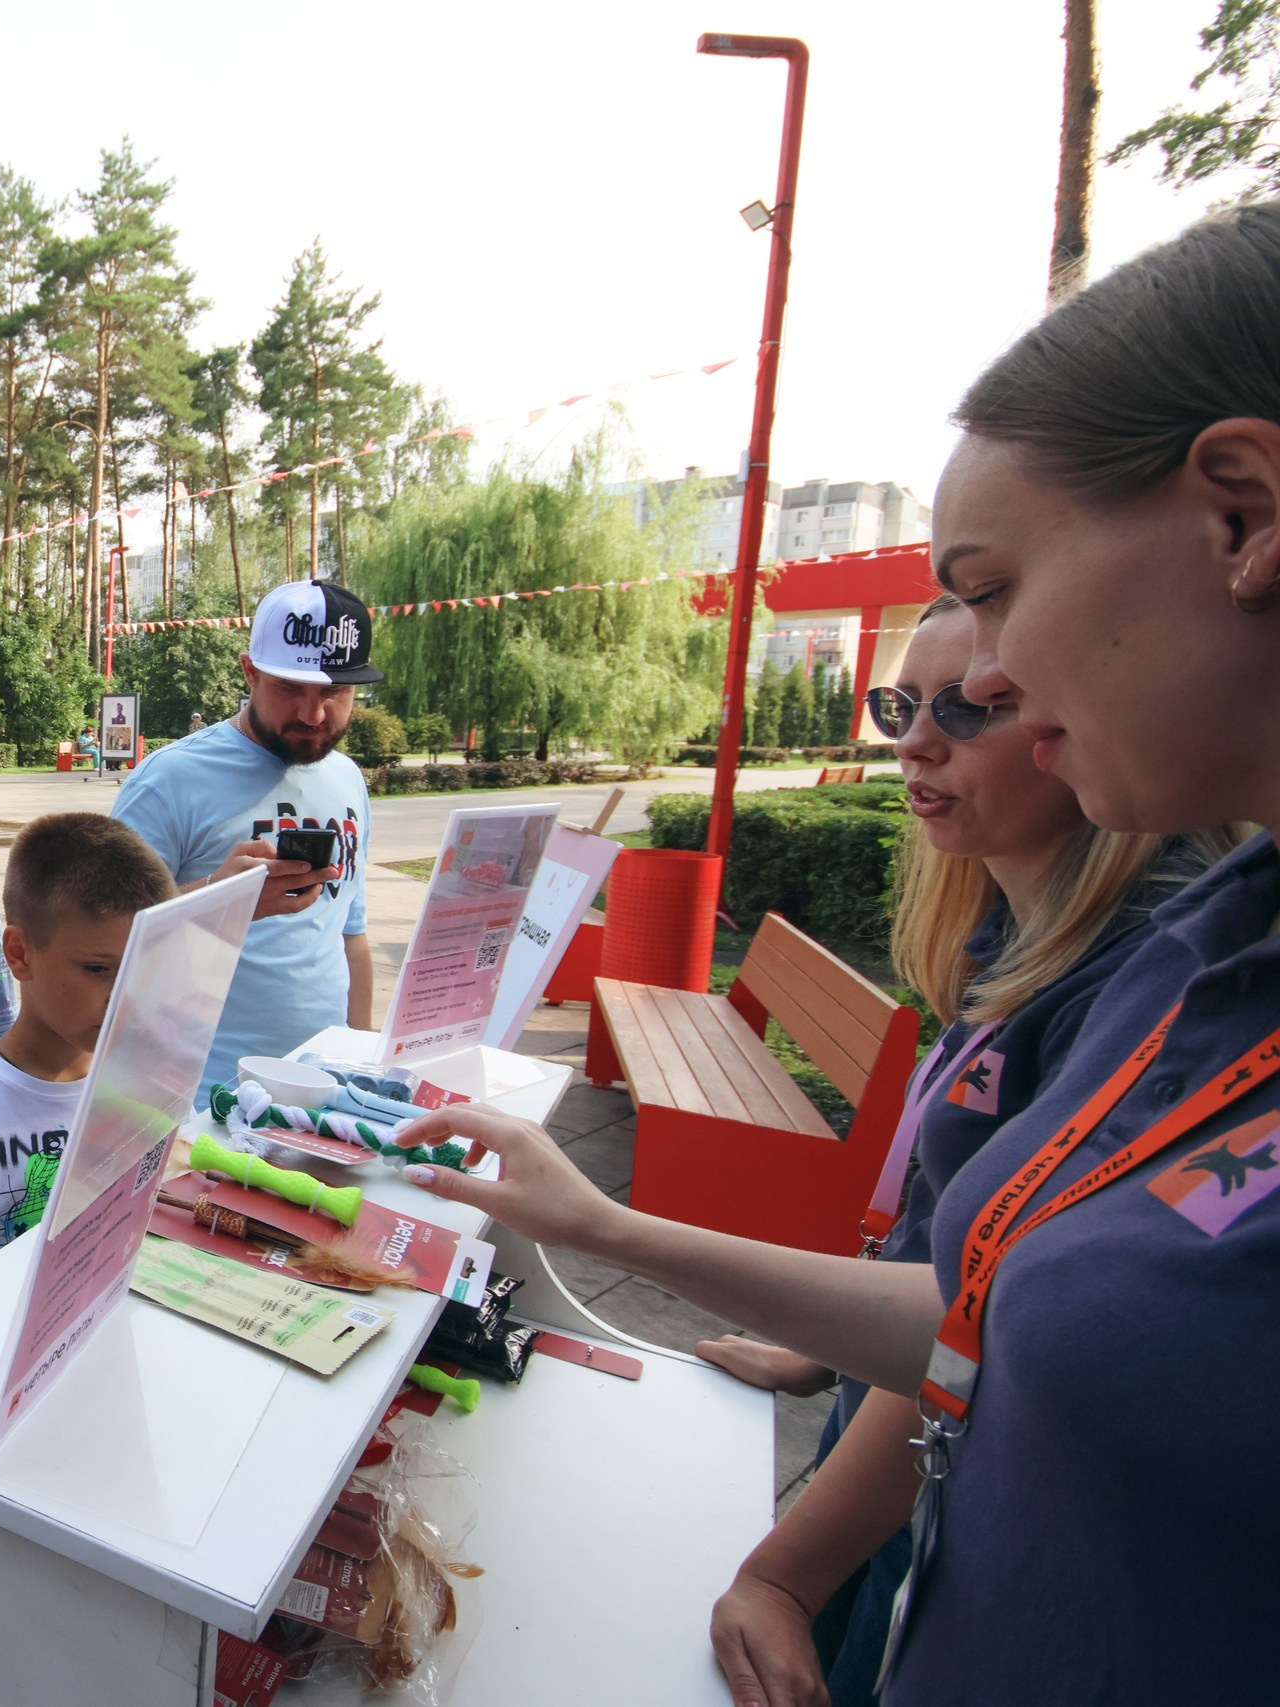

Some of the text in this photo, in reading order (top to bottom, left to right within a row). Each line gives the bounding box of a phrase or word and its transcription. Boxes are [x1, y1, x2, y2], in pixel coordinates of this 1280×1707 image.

[297, 656, 344, 665] OUTLAW
[405, 1037, 433, 1050] четыре
[1059, 1151, 1133, 1205] лапы
[967, 1156, 1054, 1279] четыре ла
[380, 1217, 417, 1270] petmax
[24, 1343, 66, 1394] четыре
[66, 1311, 95, 1351] лапы
[341, 1559, 353, 1588] etmax
[264, 1662, 282, 1691] petmax
